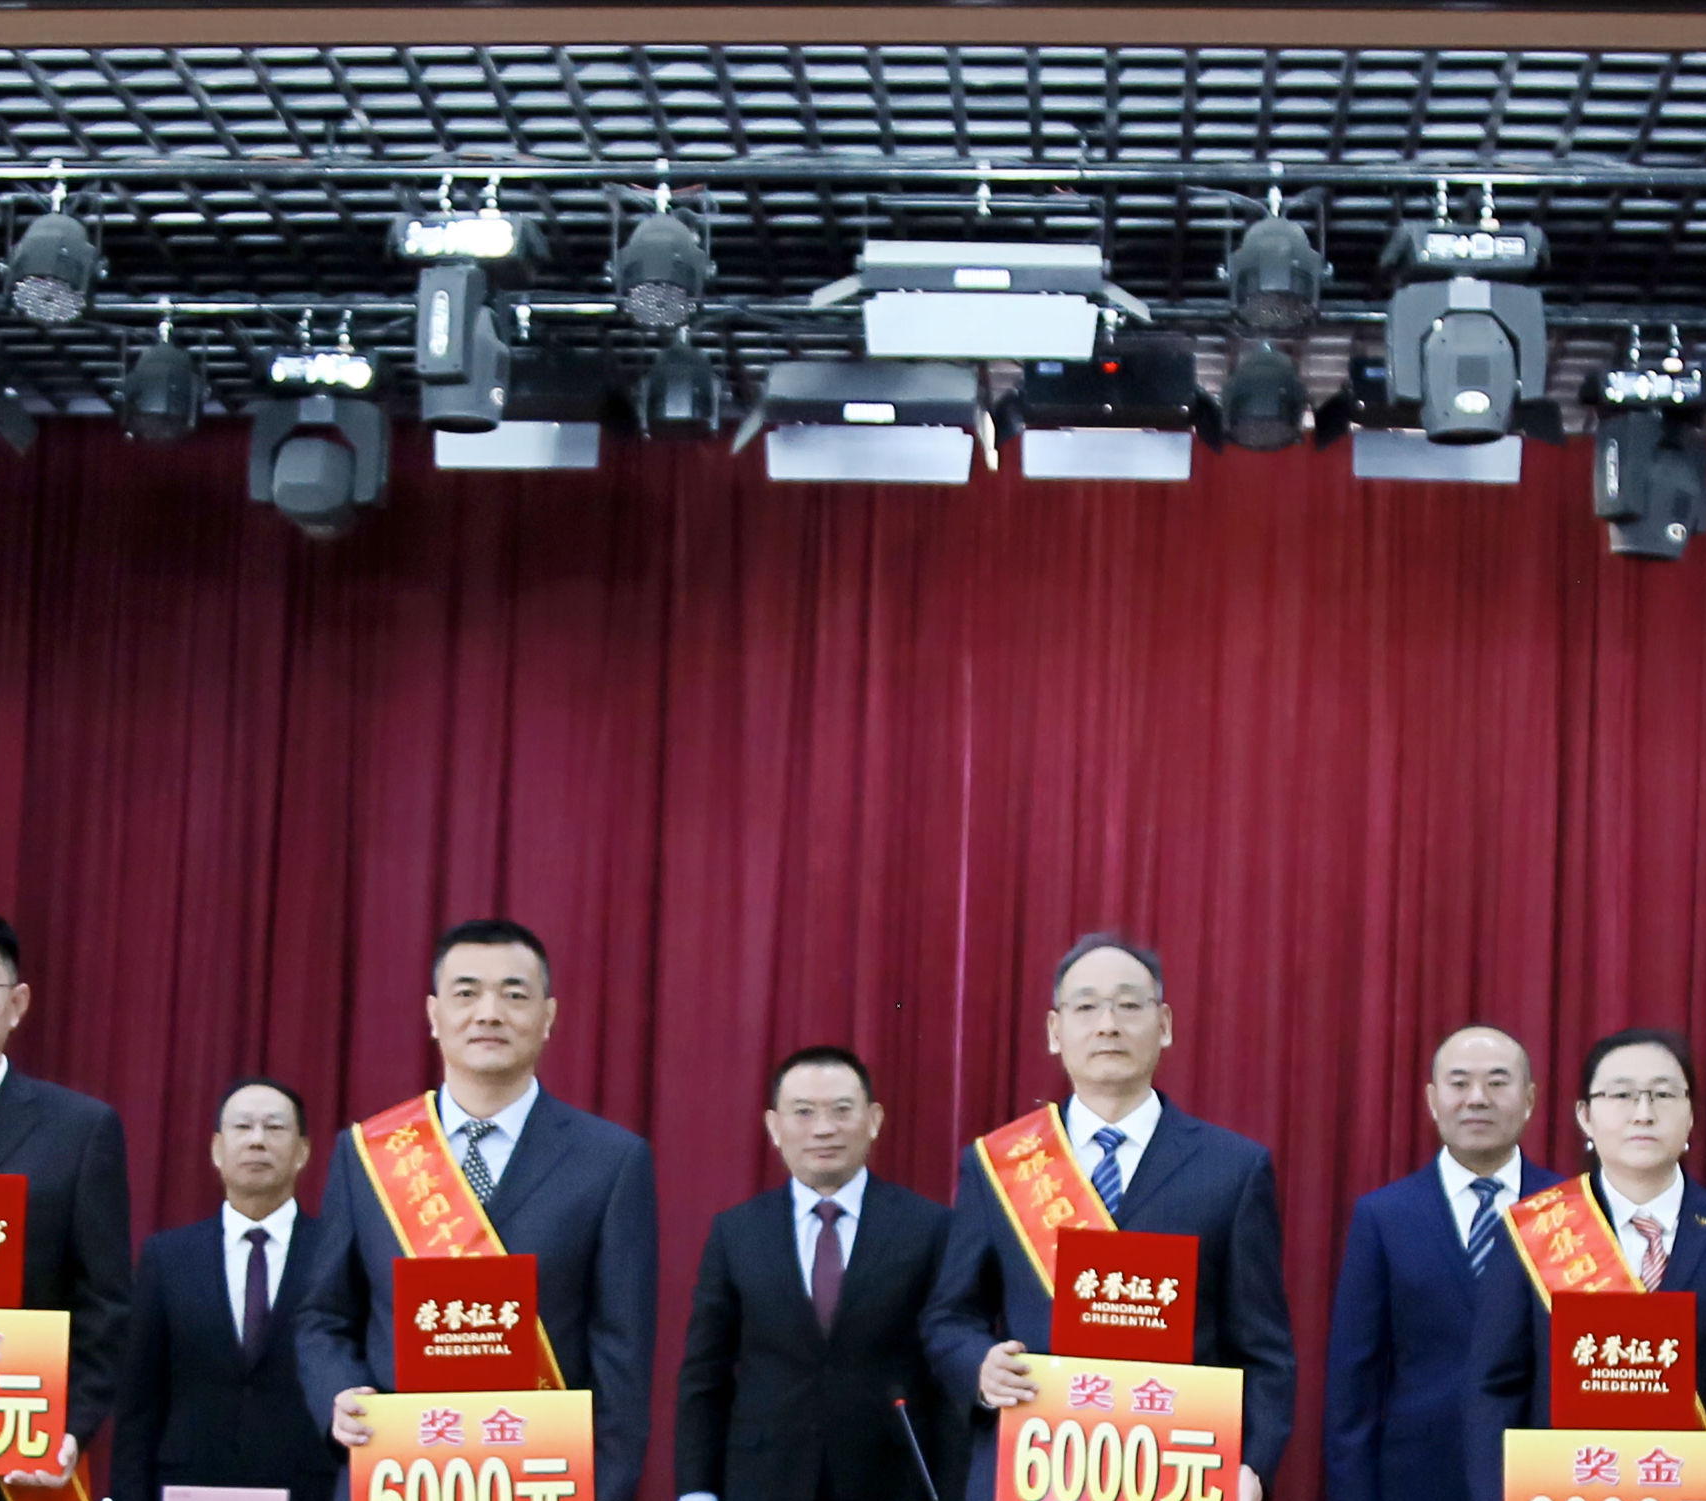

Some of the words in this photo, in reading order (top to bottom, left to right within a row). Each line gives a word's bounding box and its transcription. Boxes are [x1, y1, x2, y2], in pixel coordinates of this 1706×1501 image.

[1074, 1268, 1178, 1306] 荣誉证书
[415, 1299, 519, 1331] 荣誉证书
[1082, 1312, 1167, 1329] CREDENTIAL
[1091, 1302, 1161, 1316] HONORARY
[434, 1332, 503, 1343] HONORARY
[424, 1344, 511, 1356] CREDENTIAL
[1572, 1333, 1679, 1367] 荣誉证书
[1591, 1368, 1662, 1380] HONORARY
[1068, 1373, 1177, 1414] 奖金
[1582, 1380, 1669, 1393] CREDENTIAL
[419, 1406, 527, 1446] 奖金
[1573, 1444, 1685, 1487] 奖金
